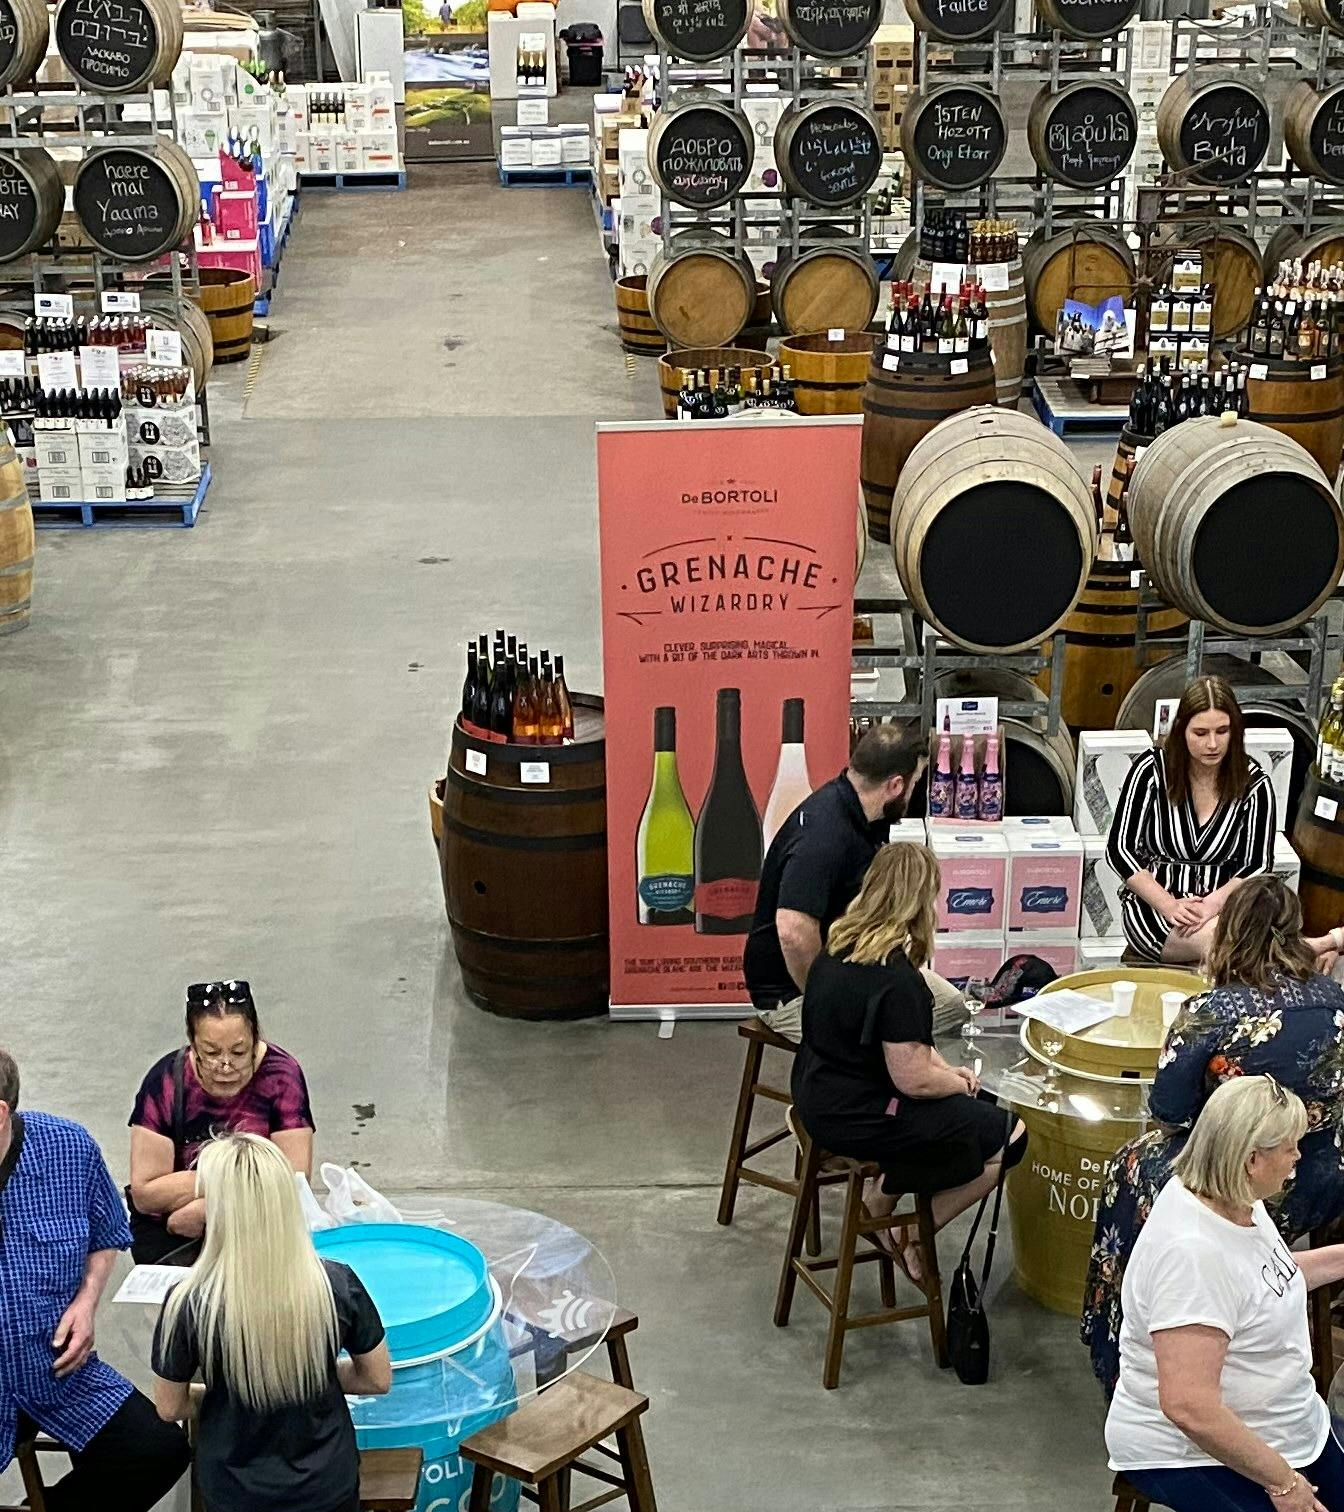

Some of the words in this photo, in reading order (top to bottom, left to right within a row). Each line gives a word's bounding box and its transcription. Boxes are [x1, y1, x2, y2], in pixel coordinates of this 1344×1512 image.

[701, 489, 778, 504] BORTOLI
[636, 553, 824, 594] GRENACHE
[670, 593, 790, 613] WIZARDRY
[702, 651, 719, 660] THE
[1080, 1158, 1101, 1174] De
[1031, 1160, 1072, 1188] HOME
[1077, 1177, 1101, 1191] OF
